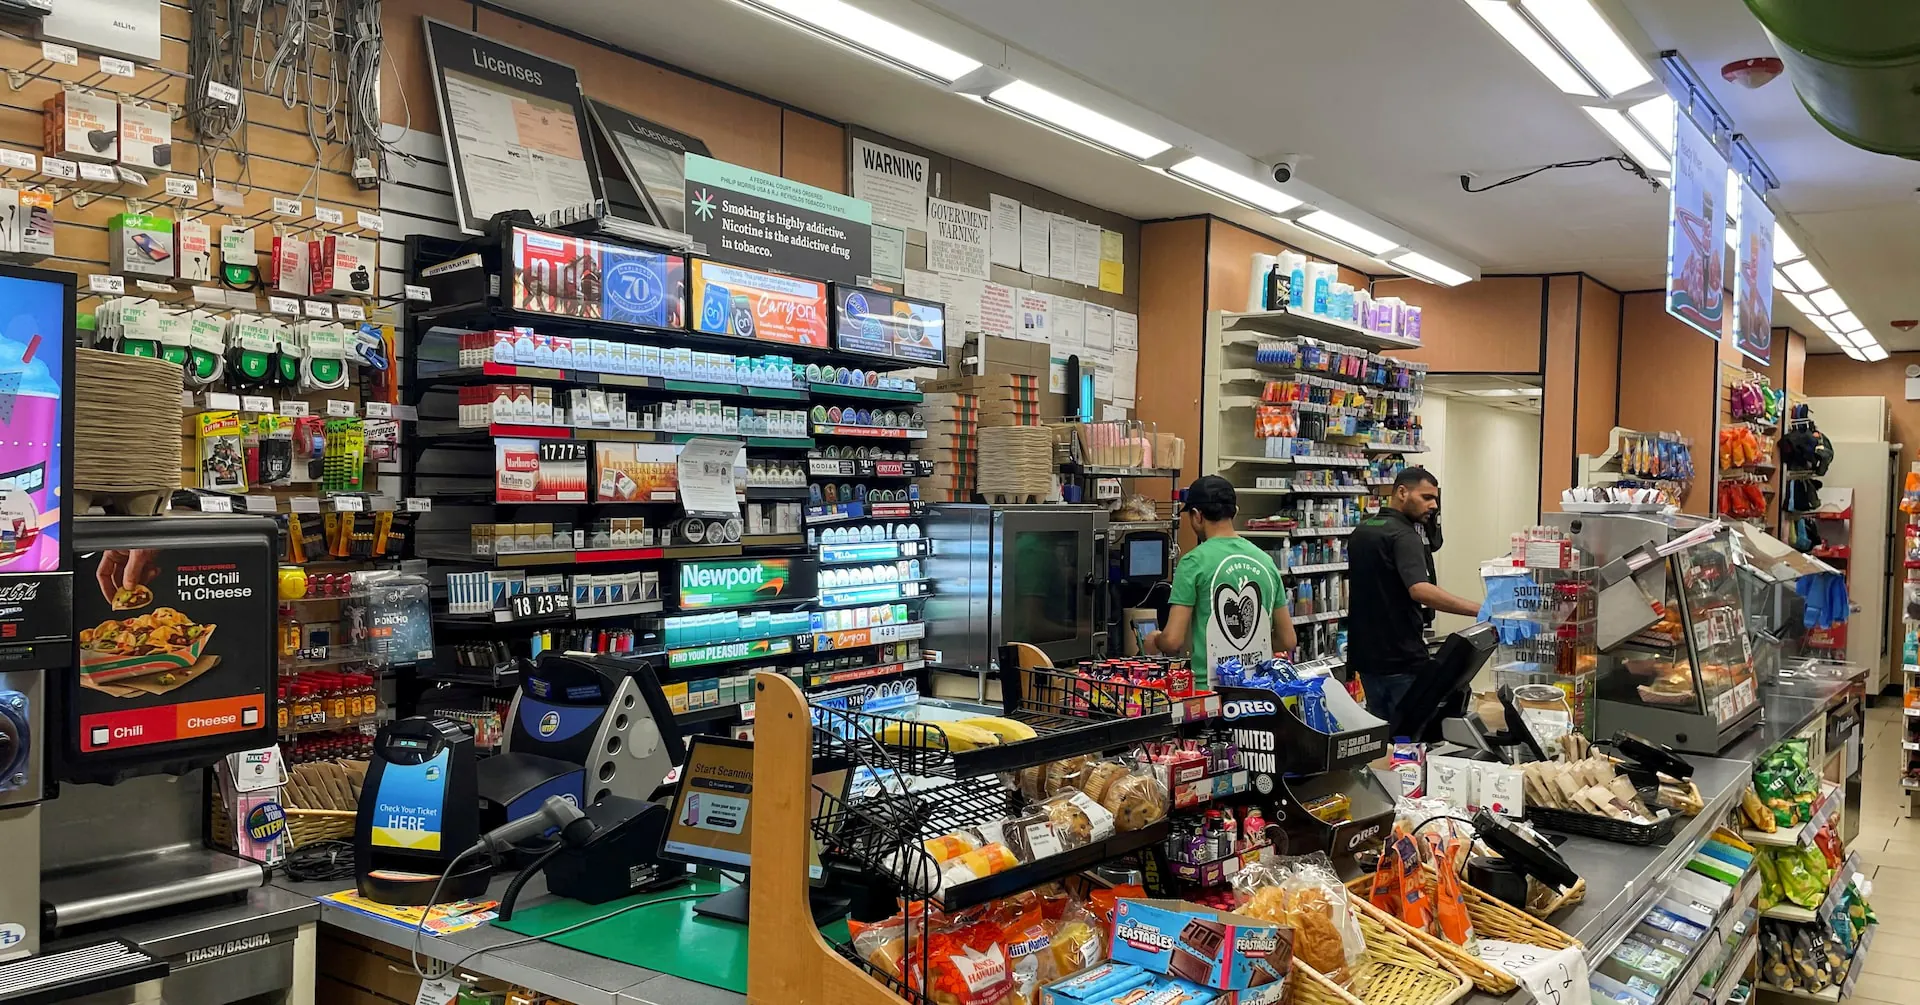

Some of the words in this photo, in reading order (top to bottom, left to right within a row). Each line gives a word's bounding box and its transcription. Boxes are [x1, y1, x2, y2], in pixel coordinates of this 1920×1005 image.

[113, 20, 136, 31] AtLite
[472, 47, 543, 86] Licenses
[627, 119, 687, 151] Licenses
[862, 146, 922, 183] WARNING
[720, 177, 736, 186] PHILIP
[736, 182, 756, 190] MORRIS
[756, 185, 766, 193] USA
[780, 192, 804, 204] REYNOLDS
[804, 198, 826, 209] TOBACCO
[754, 176, 775, 188] FEDERAL
[776, 182, 792, 192] COURT
[802, 190, 823, 200] ORDERED
[722, 200, 766, 224] Smoking
[766, 210, 776, 222] is
[776, 212, 804, 233] highly
[806, 220, 847, 240] addictive.
[930, 202, 988, 230] GOVERNMENT
[722, 218, 764, 238] Nicotine
[764, 227, 773, 239] is
[774, 230, 790, 244] the
[790, 234, 830, 253] addictive
[830, 242, 850, 260] drug
[938, 221, 981, 245] WARNING:
[722, 236, 733, 249] in
[734, 239, 773, 258] tobacco.
[621, 275, 650, 302] 70
[363, 424, 396, 438] Energizer
[811, 462, 838, 470] KODIAK
[177, 574, 207, 587] Hot
[208, 571, 240, 586] Chili
[683, 564, 764, 590] Newport
[194, 585, 252, 600] Cheese
[538, 596, 554, 615] 23
[1517, 598, 1562, 612] COMFORT
[374, 616, 408, 626] PONCHO
[672, 652, 688, 664] FIND
[688, 650, 706, 662] YOUR
[706, 642, 750, 660] PLEASURE
[1223, 700, 1277, 722] OREO
[114, 724, 144, 738] Chili
[187, 713, 236, 730] Cheese
[247, 754, 263, 762] TAKE
[262, 752, 271, 762] 5
[694, 763, 716, 774] Start
[266, 811, 282, 822] YORK
[380, 804, 400, 812] Check
[401, 806, 416, 814] Your
[417, 806, 438, 816] Ticket
[251, 820, 284, 839] LOTTERY
[388, 814, 426, 832] HERE
[1349, 824, 1380, 848] OREO
[1117, 926, 1174, 950] FEASTABLES
[1236, 938, 1277, 952] FEASTABLES
[184, 933, 271, 964] TRASH/BASURA
[968, 964, 1004, 984] HAWAIIAN
